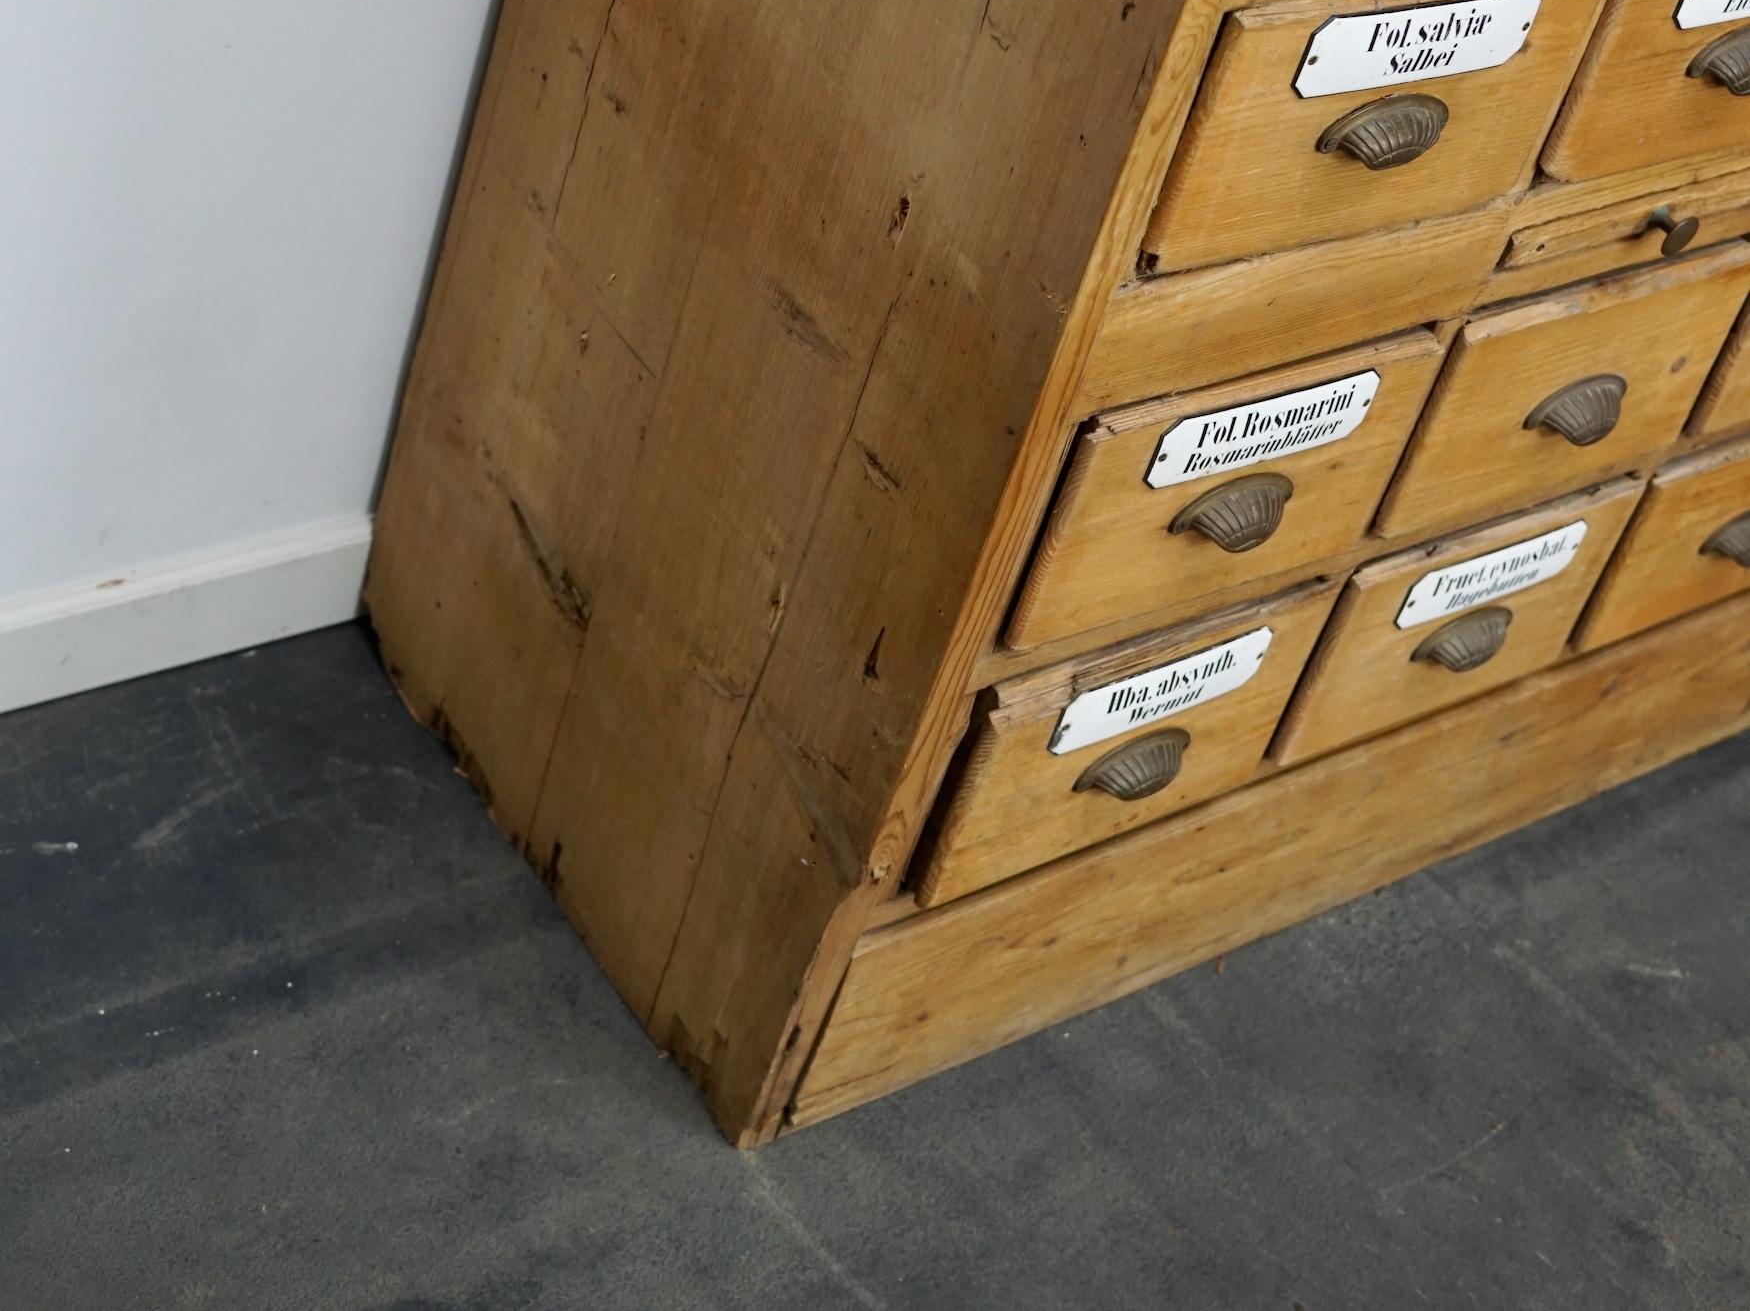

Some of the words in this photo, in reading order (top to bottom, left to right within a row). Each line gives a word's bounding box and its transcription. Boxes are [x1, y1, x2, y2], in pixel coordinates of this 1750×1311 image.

[1383, 43, 1458, 76] Salbei
[1197, 416, 1237, 449] Fol.
[1241, 384, 1357, 439] Rosmarini
[1182, 420, 1343, 474] Rosmarinblätter
[1129, 685, 1205, 724] Wermut
